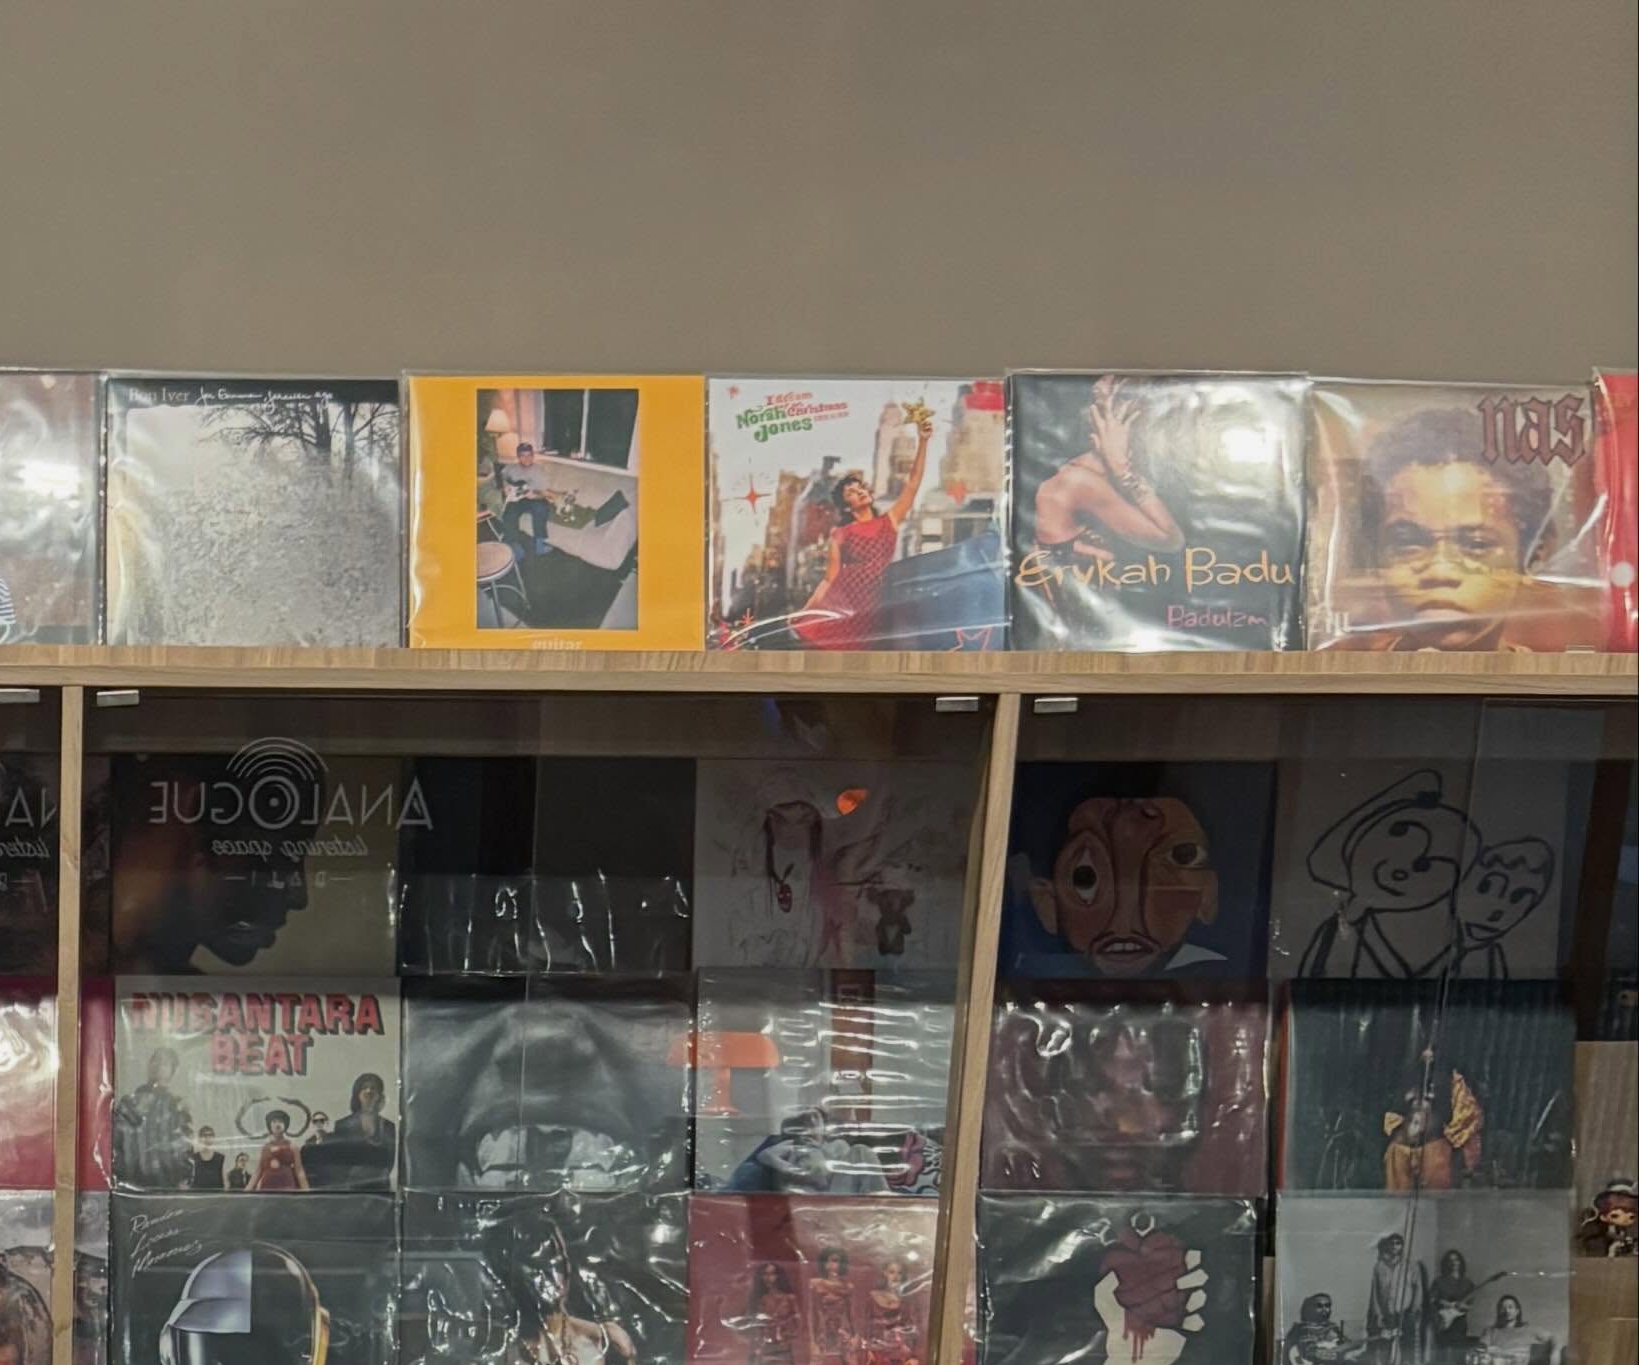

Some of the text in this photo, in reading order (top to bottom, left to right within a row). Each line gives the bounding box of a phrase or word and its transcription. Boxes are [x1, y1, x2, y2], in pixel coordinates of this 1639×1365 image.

[162, 388, 191, 401] Iver
[737, 405, 787, 429] Norah
[754, 417, 813, 442] Jones
[1015, 547, 1296, 593] Erykah Badu
[129, 992, 384, 1036] NUSANTARA
[208, 1033, 313, 1076] BEAT
